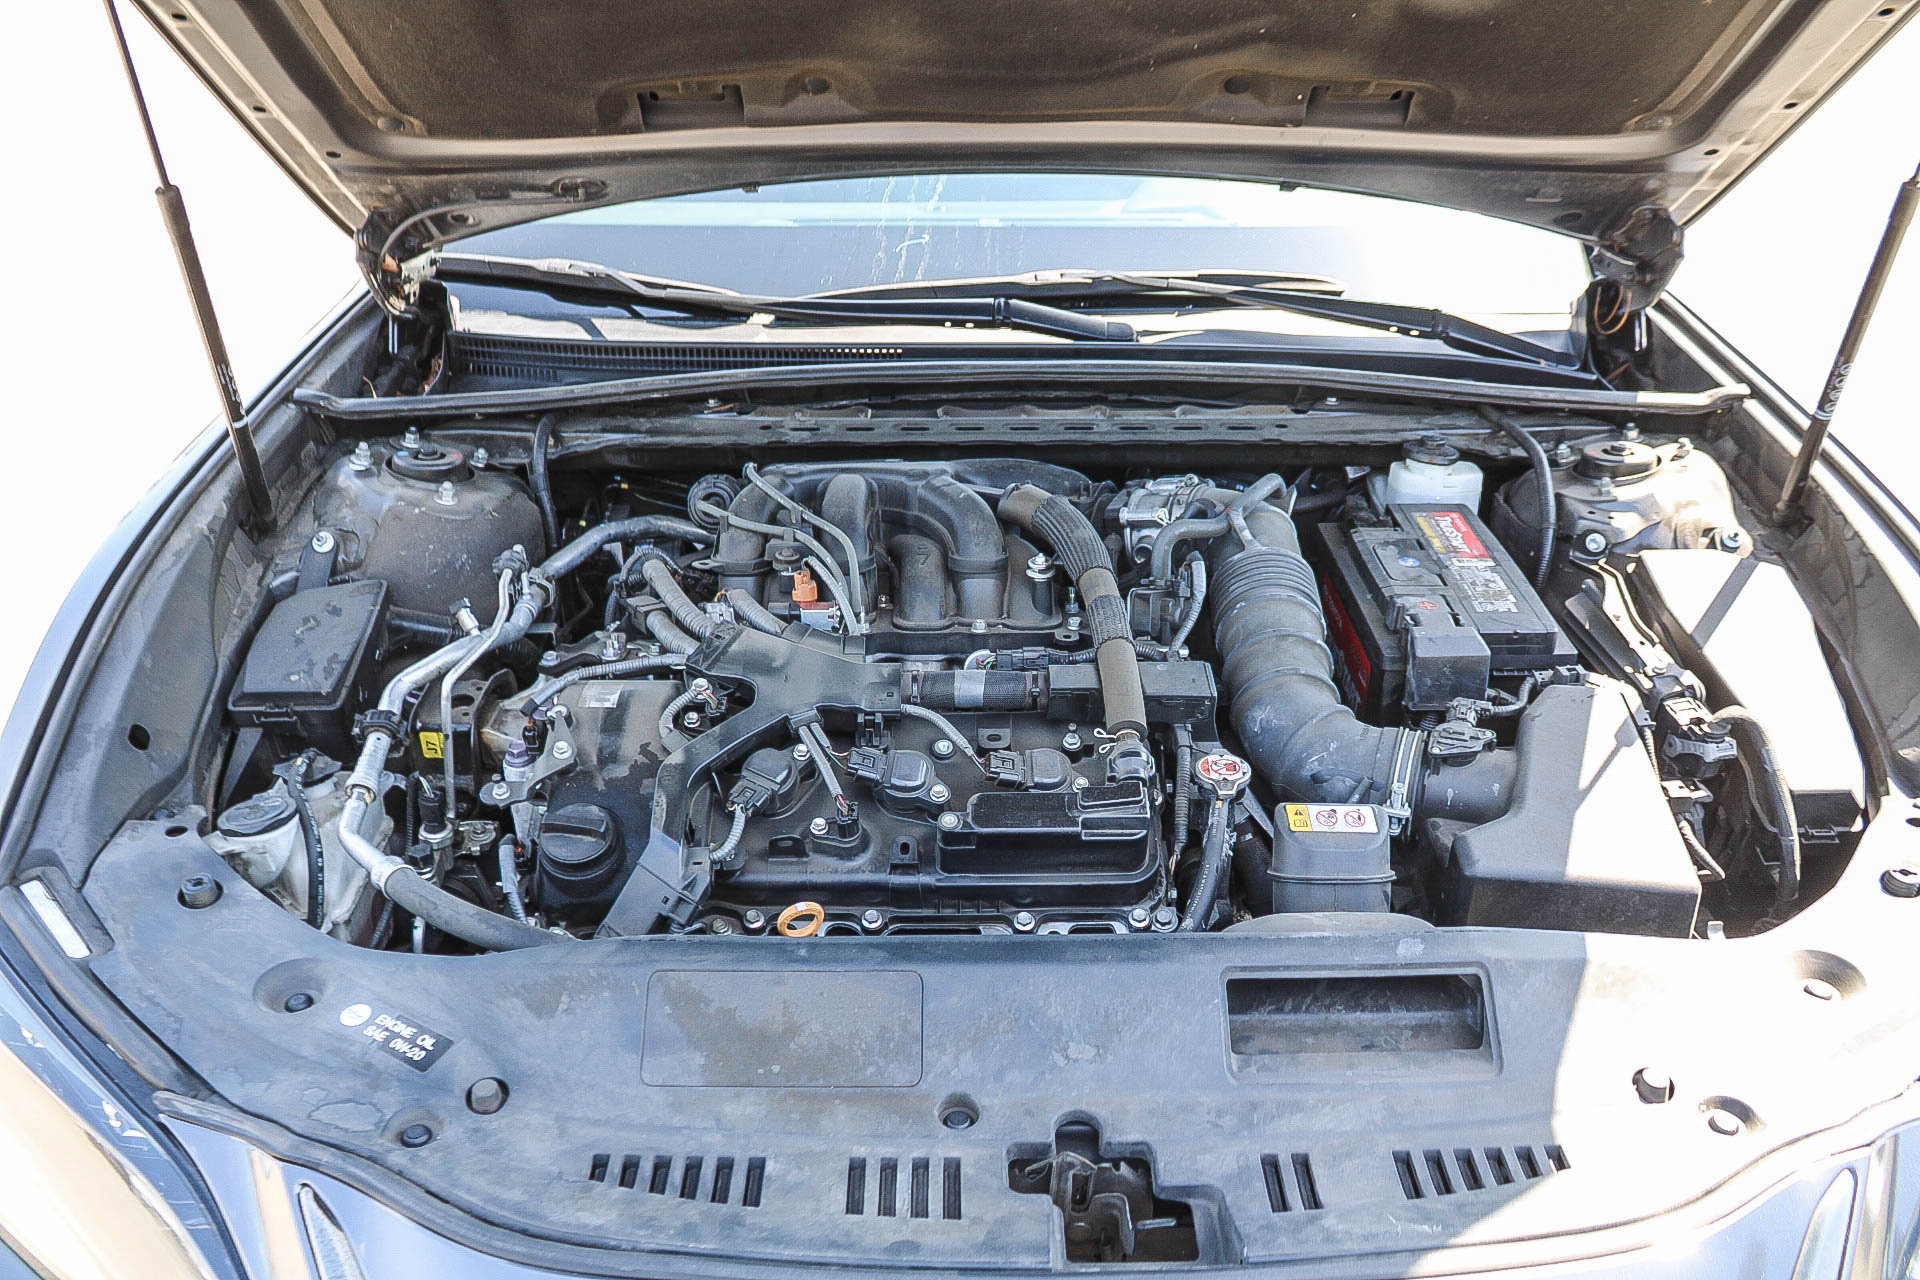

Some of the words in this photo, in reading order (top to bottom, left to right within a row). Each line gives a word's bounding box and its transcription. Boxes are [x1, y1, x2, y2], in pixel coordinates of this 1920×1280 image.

[426, 740, 438, 754] J7
[362, 1025, 390, 1042] SAE
[388, 1038, 427, 1061] 0W-20
[374, 1014, 418, 1038] ENGINE
[416, 1034, 437, 1051] OIL
